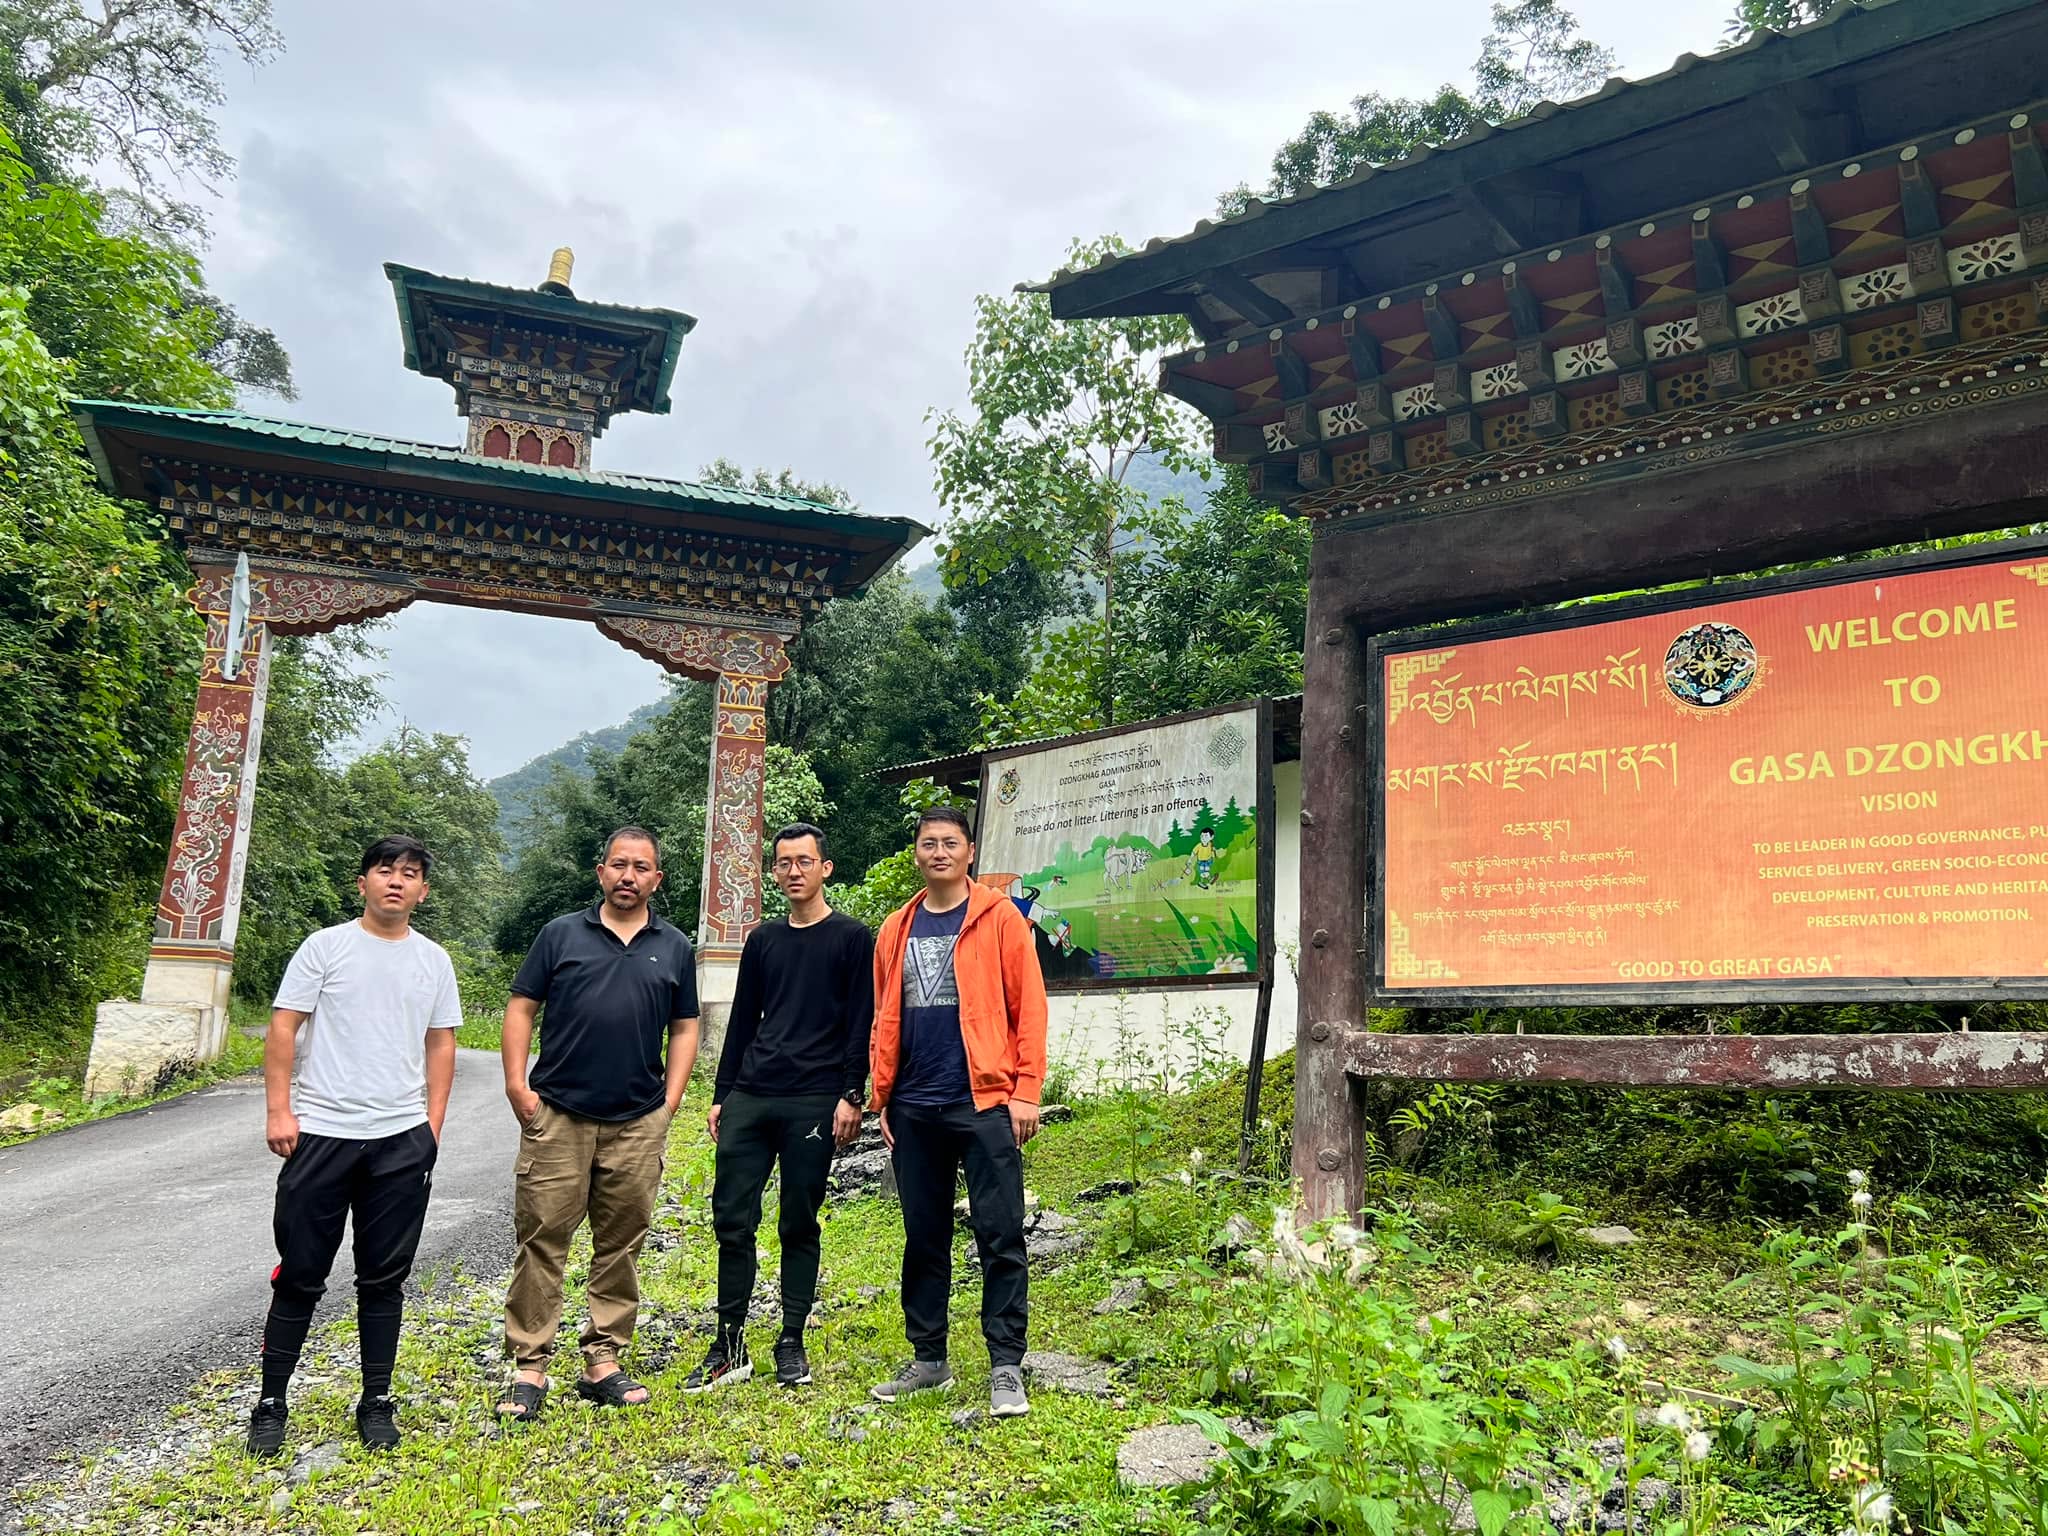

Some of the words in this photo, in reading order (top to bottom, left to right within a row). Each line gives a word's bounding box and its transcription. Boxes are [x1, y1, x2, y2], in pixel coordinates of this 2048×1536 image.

[1805, 598, 2018, 653] WELCOME
[1883, 674, 1942, 708] TO
[1059, 770, 1100, 786] DZONGKHAG
[1100, 759, 1161, 777] ADMINISTRATION
[1729, 750, 1835, 785] GASA
[1098, 779, 1117, 790] GASA
[1861, 789, 1938, 813] VISION
[1015, 823, 1042, 837] Please
[1043, 820, 1055, 832] do
[1056, 818, 1073, 830] not
[1074, 814, 1098, 827] litter.
[1100, 805, 1139, 820] Littering
[1141, 804, 1149, 815] is
[1151, 802, 1164, 814] an
[1752, 842, 1771, 856] TO
[1774, 841, 1791, 854] BE
[1793, 837, 1848, 853] LEADER
[1850, 836, 1866, 849] IN
[1868, 833, 1913, 848] GOOD
[1916, 826, 2026, 846] GOVERNANCE,
[1758, 865, 1814, 880] SERVICE
[1816, 861, 1889, 877] DELIVERY,
[1891, 858, 1941, 873] GREEN
[1772, 887, 1880, 905] DEVELOPMENT,
[1883, 884, 1951, 899] CULTURE
[1954, 882, 1989, 897] AND
[1991, 879, 2048, 895] HERITA
[1807, 912, 1915, 928] PRESERVATION
[1917, 911, 1929, 924] &
[1932, 908, 2034, 924] PROMOTION.
[1677, 959, 1704, 977] TO
[1708, 957, 1773, 976] GREAT
